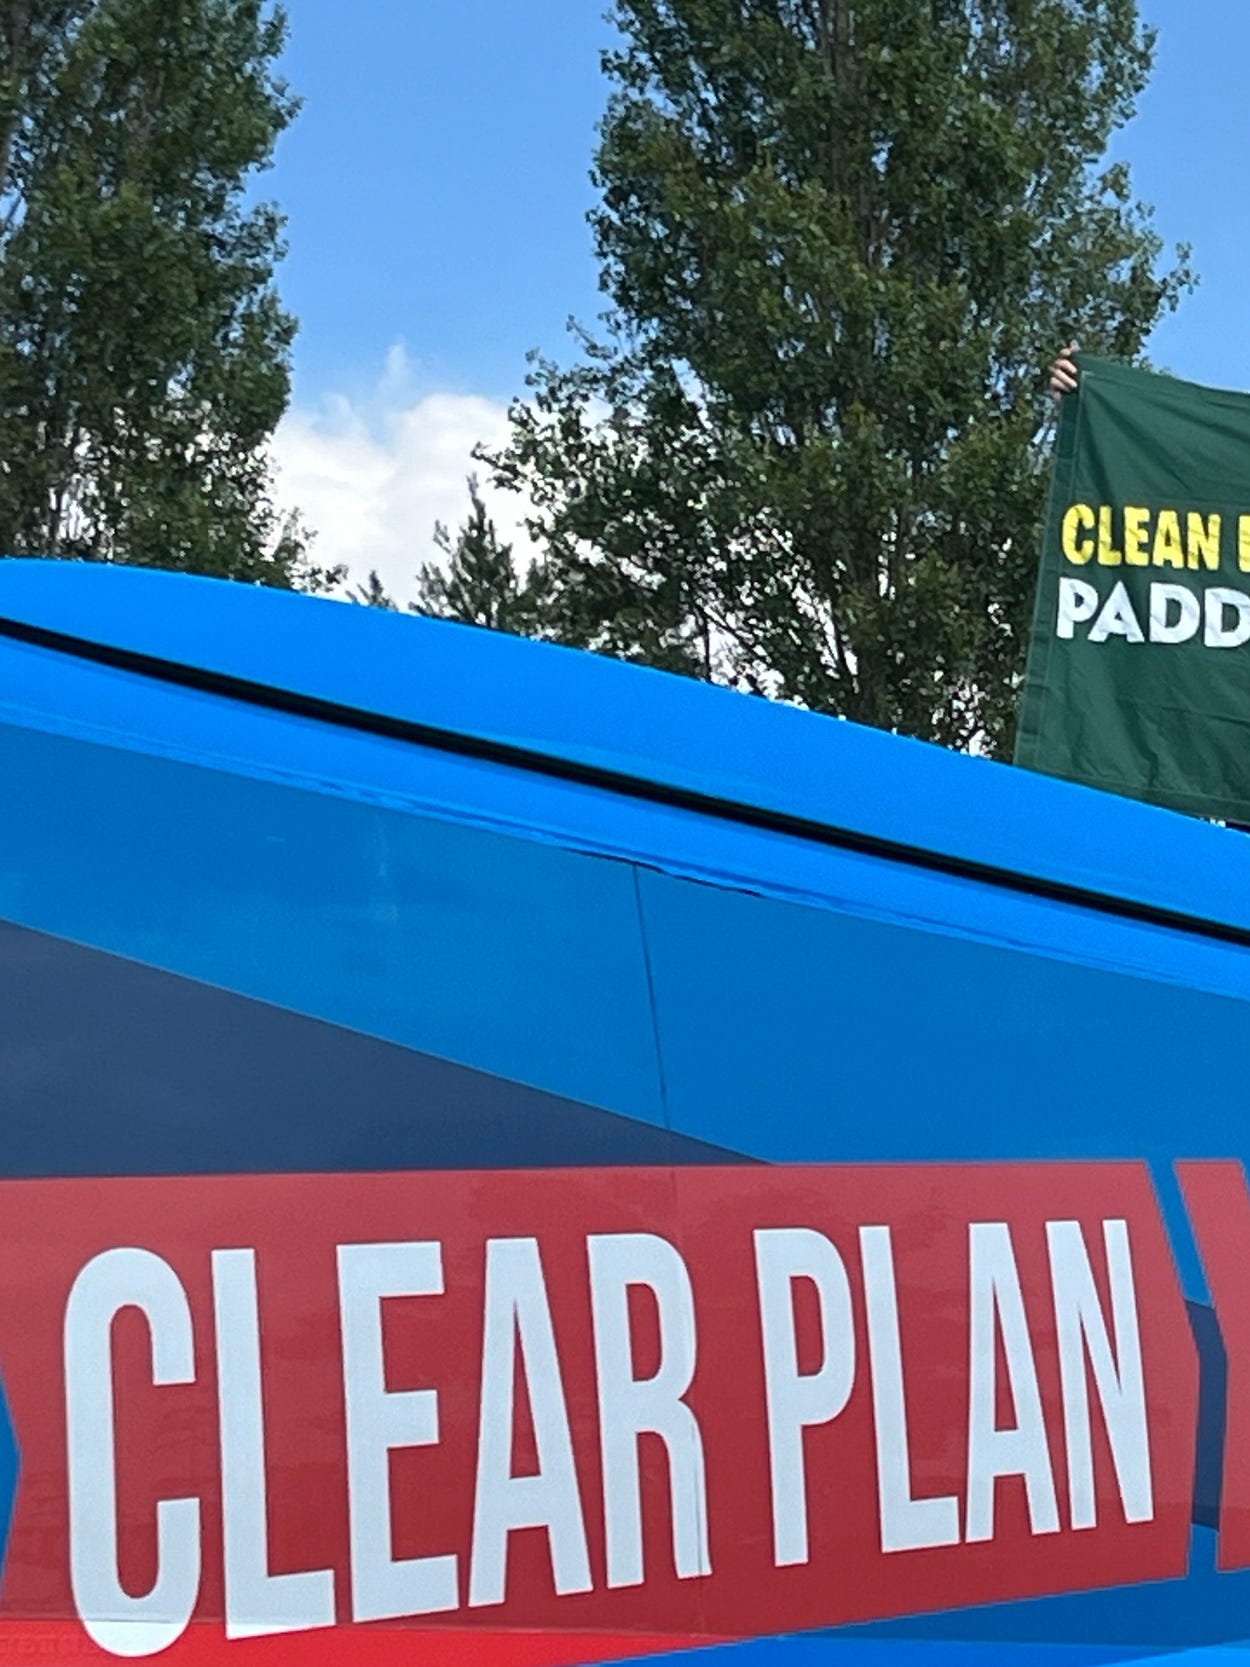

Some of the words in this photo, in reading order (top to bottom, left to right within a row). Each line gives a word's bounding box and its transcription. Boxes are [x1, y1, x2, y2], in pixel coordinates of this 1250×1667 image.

[1061, 503, 1222, 571] CLEAN
[63, 1232, 713, 1658] CLEAR
[753, 1219, 1154, 1567] PLAN
